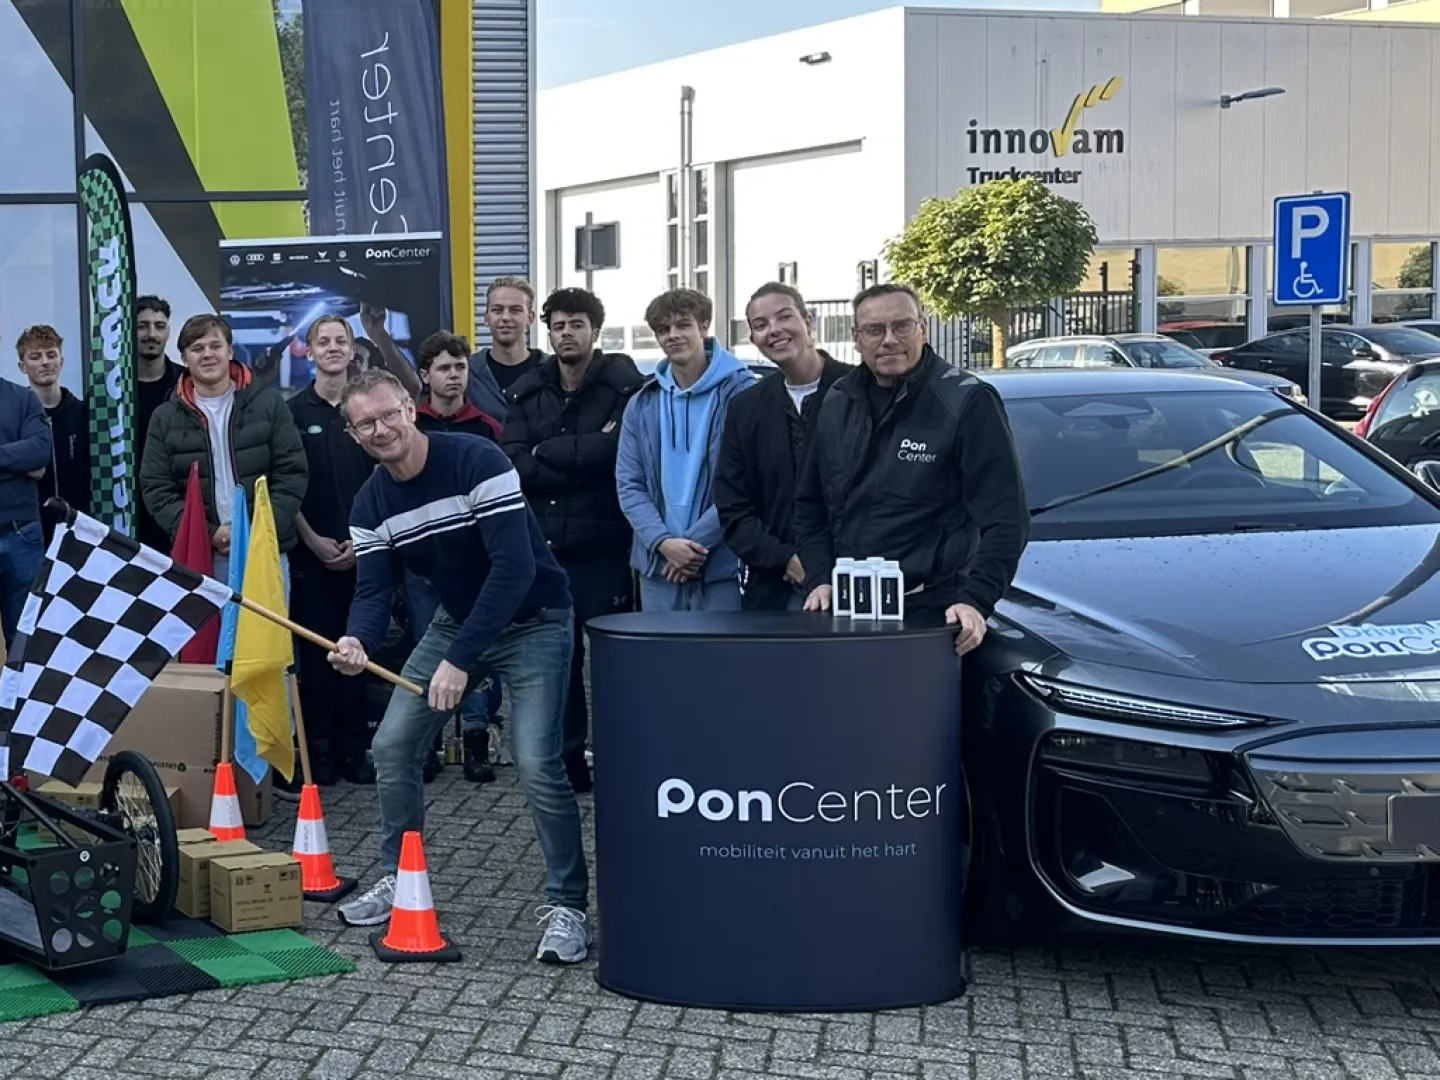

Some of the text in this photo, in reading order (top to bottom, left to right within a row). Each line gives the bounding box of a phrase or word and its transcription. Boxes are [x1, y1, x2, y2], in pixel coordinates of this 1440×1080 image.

[966, 92, 1125, 158] innovam
[966, 166, 1082, 185] Truckcenter
[1291, 205, 1330, 259] P
[365, 246, 431, 260] PonCenter
[900, 438, 927, 451] Pon
[897, 449, 937, 463] Center
[657, 778, 947, 822] PonCenter
[699, 842, 917, 860] mobiliteit vanuit het hart
